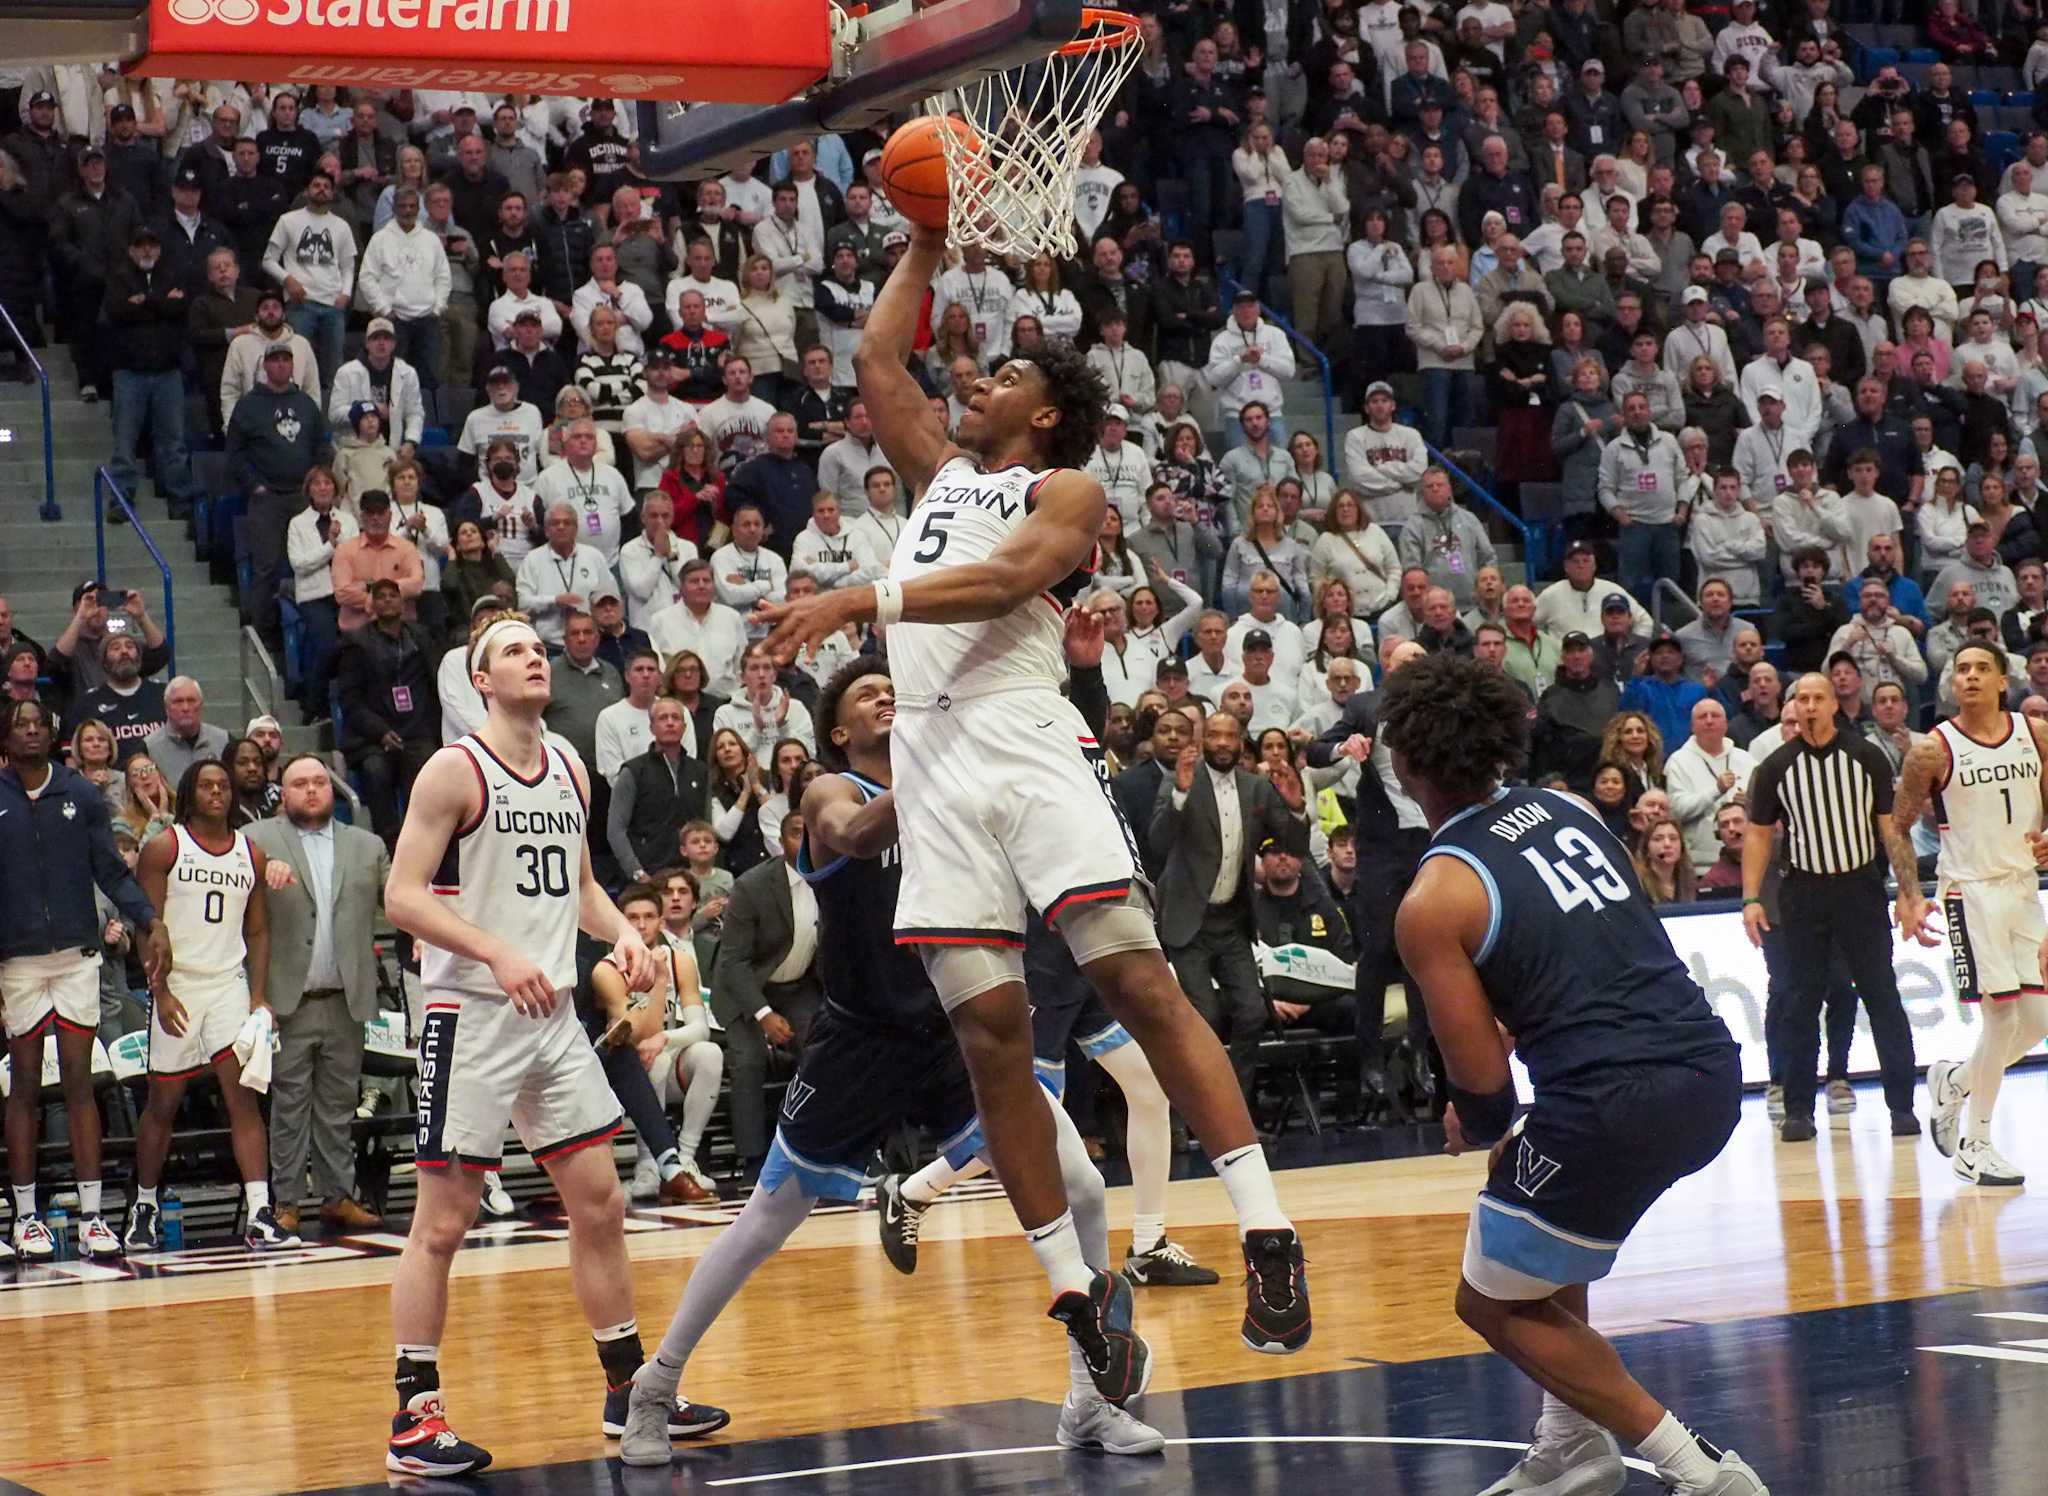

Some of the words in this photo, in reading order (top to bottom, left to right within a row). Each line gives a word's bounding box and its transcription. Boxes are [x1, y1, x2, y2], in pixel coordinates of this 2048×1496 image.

[265, 145, 303, 157] UCONN
[275, 156, 288, 174] 5
[921, 485, 1019, 521] CONN
[913, 511, 955, 563] 5
[1959, 762, 2039, 788] UCONN
[495, 809, 582, 835] UCONN
[1489, 801, 1553, 843] DIXON
[2000, 787, 2012, 824] 1
[178, 866, 252, 891] UCONN
[516, 844, 570, 898] 30
[1520, 826, 1632, 914] 43
[205, 890, 224, 924] 0
[418, 1018, 442, 1146] HUSKIES
